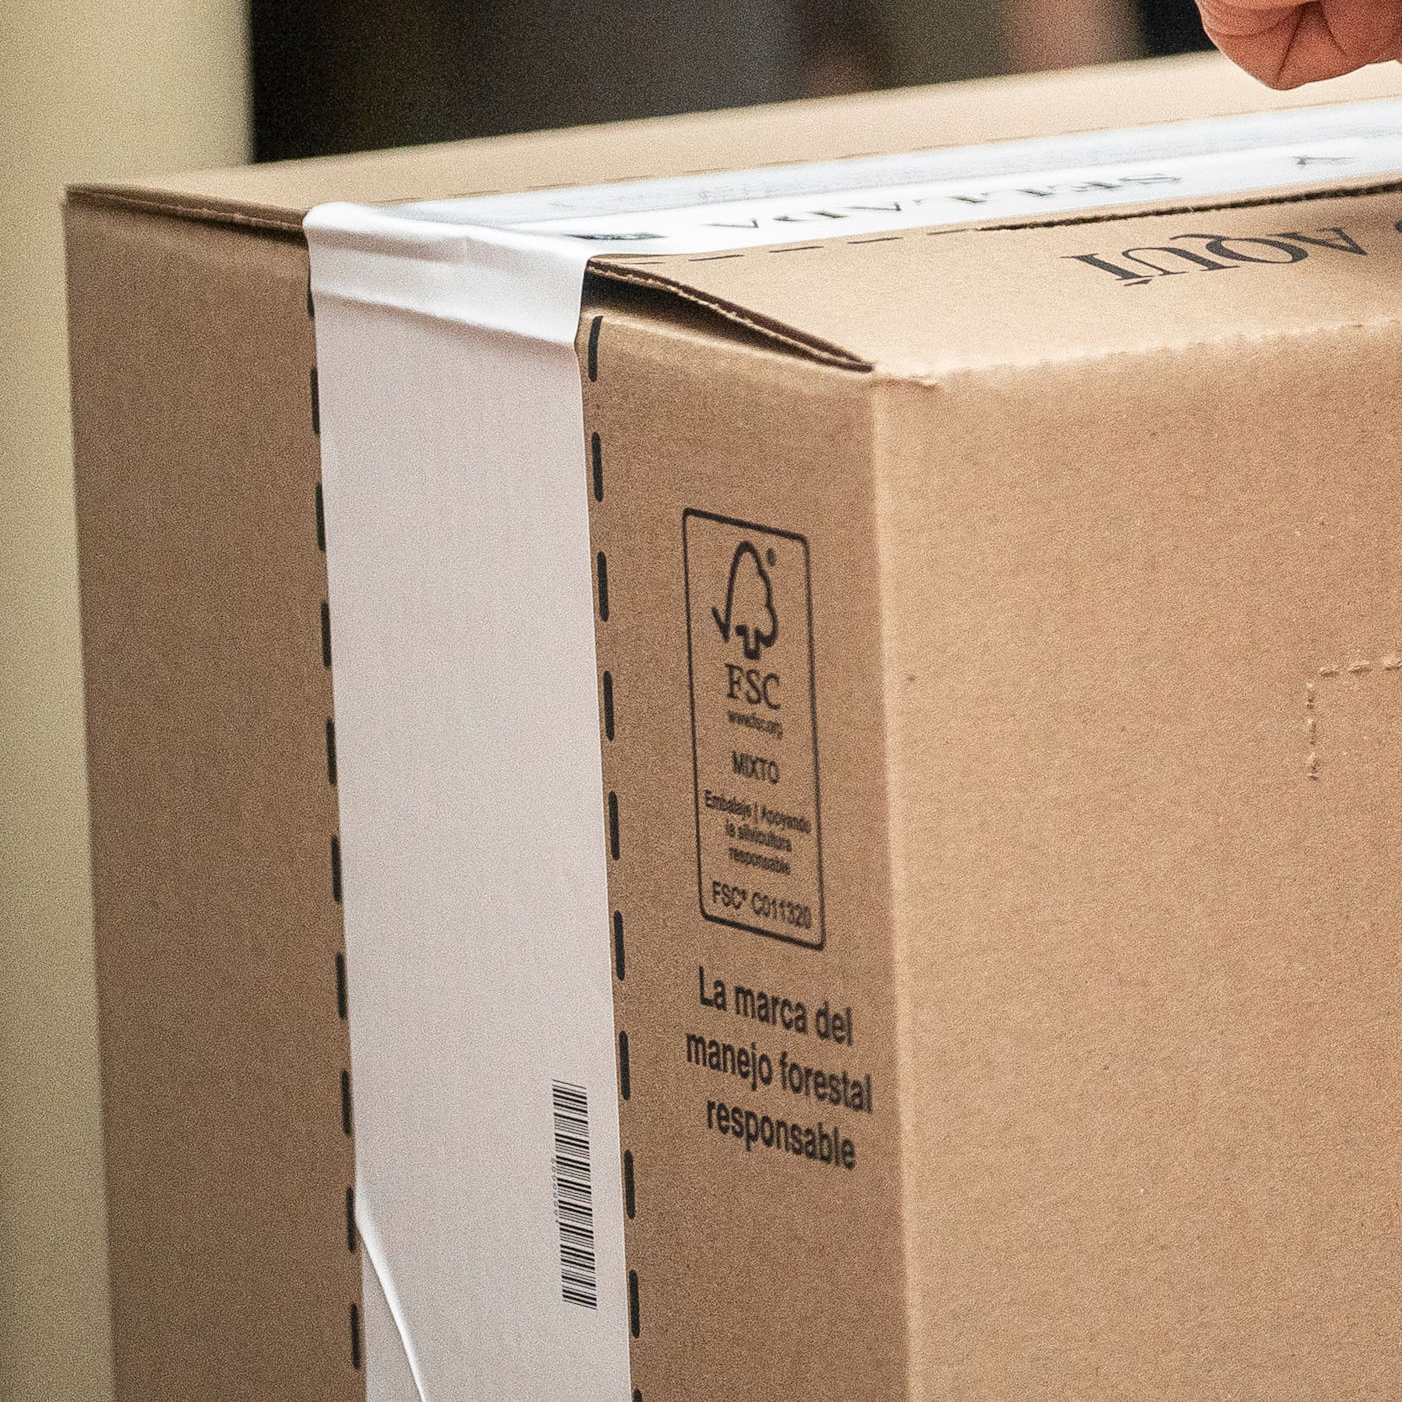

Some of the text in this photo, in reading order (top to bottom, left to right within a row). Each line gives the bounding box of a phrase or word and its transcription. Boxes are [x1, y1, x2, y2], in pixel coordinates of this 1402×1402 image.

[1059, 225, 1369, 287] AQUÍ
[723, 662, 782, 711] FSC
[731, 749, 781, 786] MIXTO
[698, 964, 854, 1048] La marca del
[686, 1032, 873, 1115] manejo forestal
[706, 1099, 857, 1171] responsable
